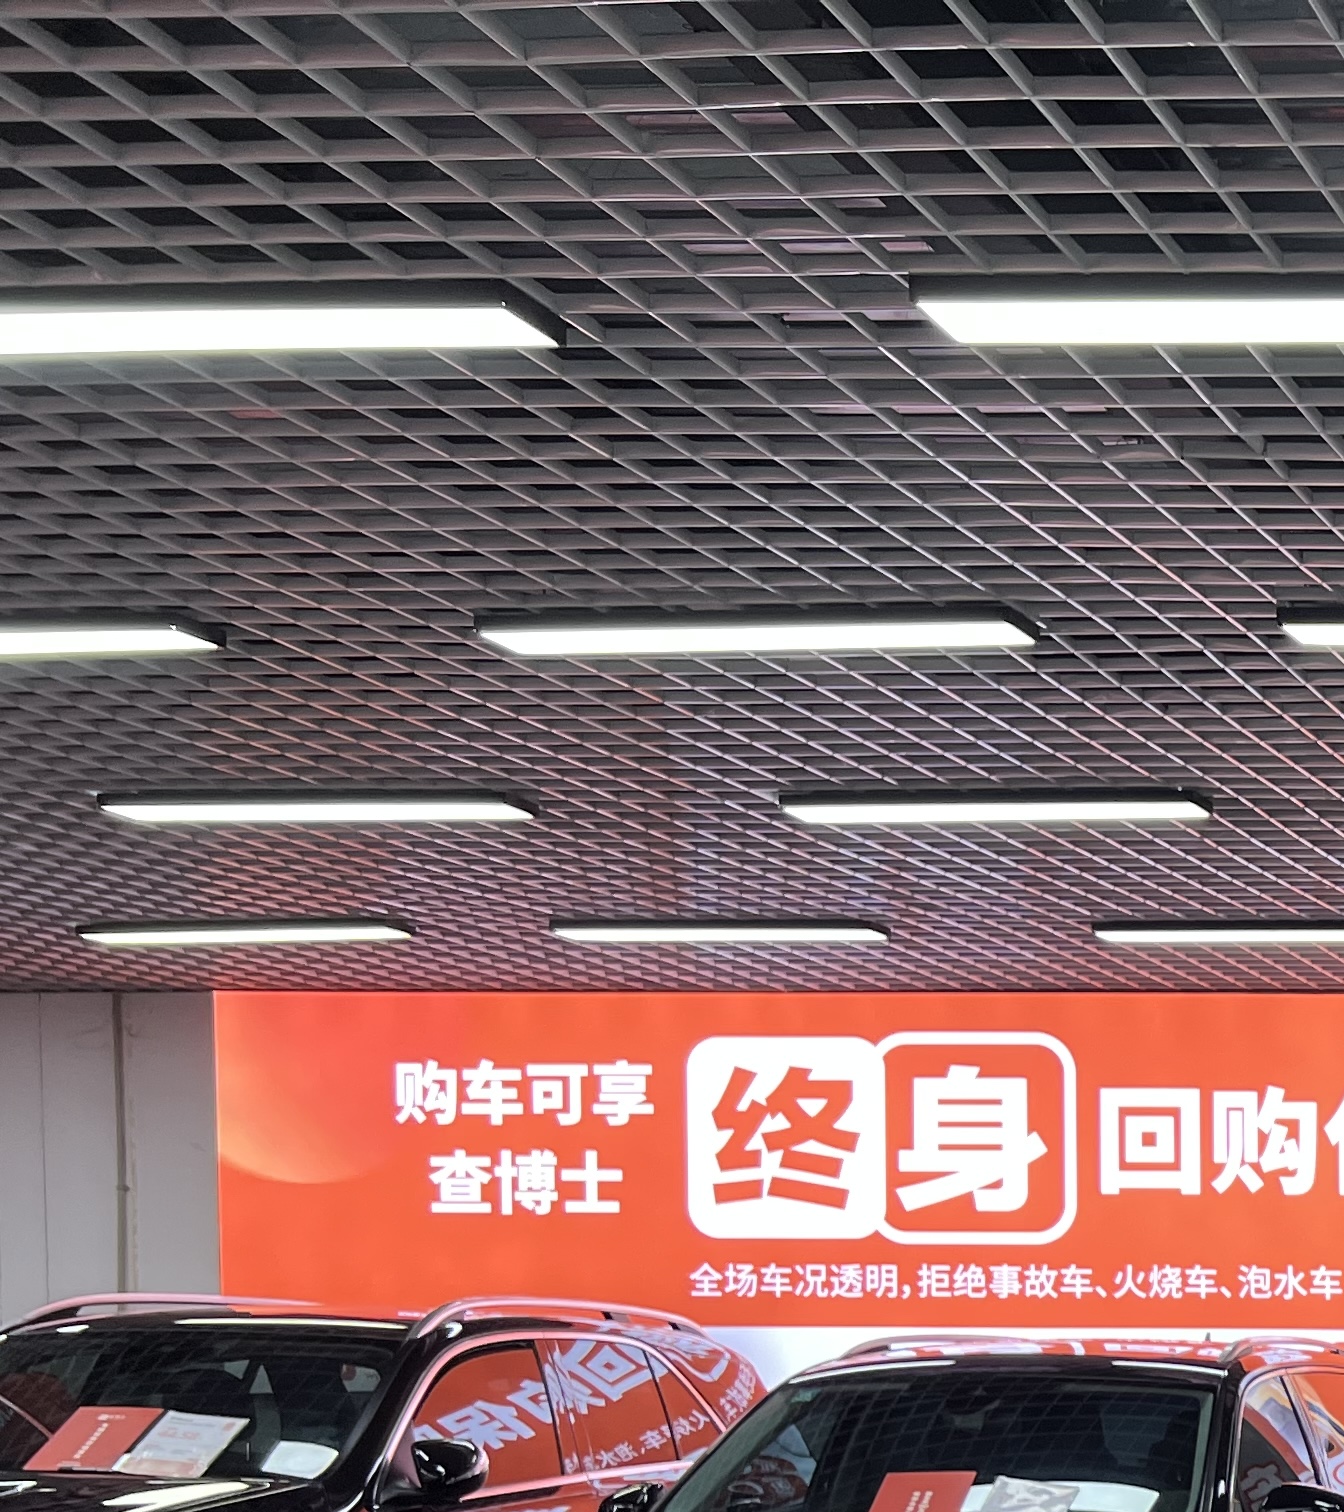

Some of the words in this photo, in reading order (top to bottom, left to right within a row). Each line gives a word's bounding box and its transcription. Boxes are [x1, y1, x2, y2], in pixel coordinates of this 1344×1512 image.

[396, 1059, 656, 1128] 购车可享
[429, 1149, 624, 1217] 查博士
